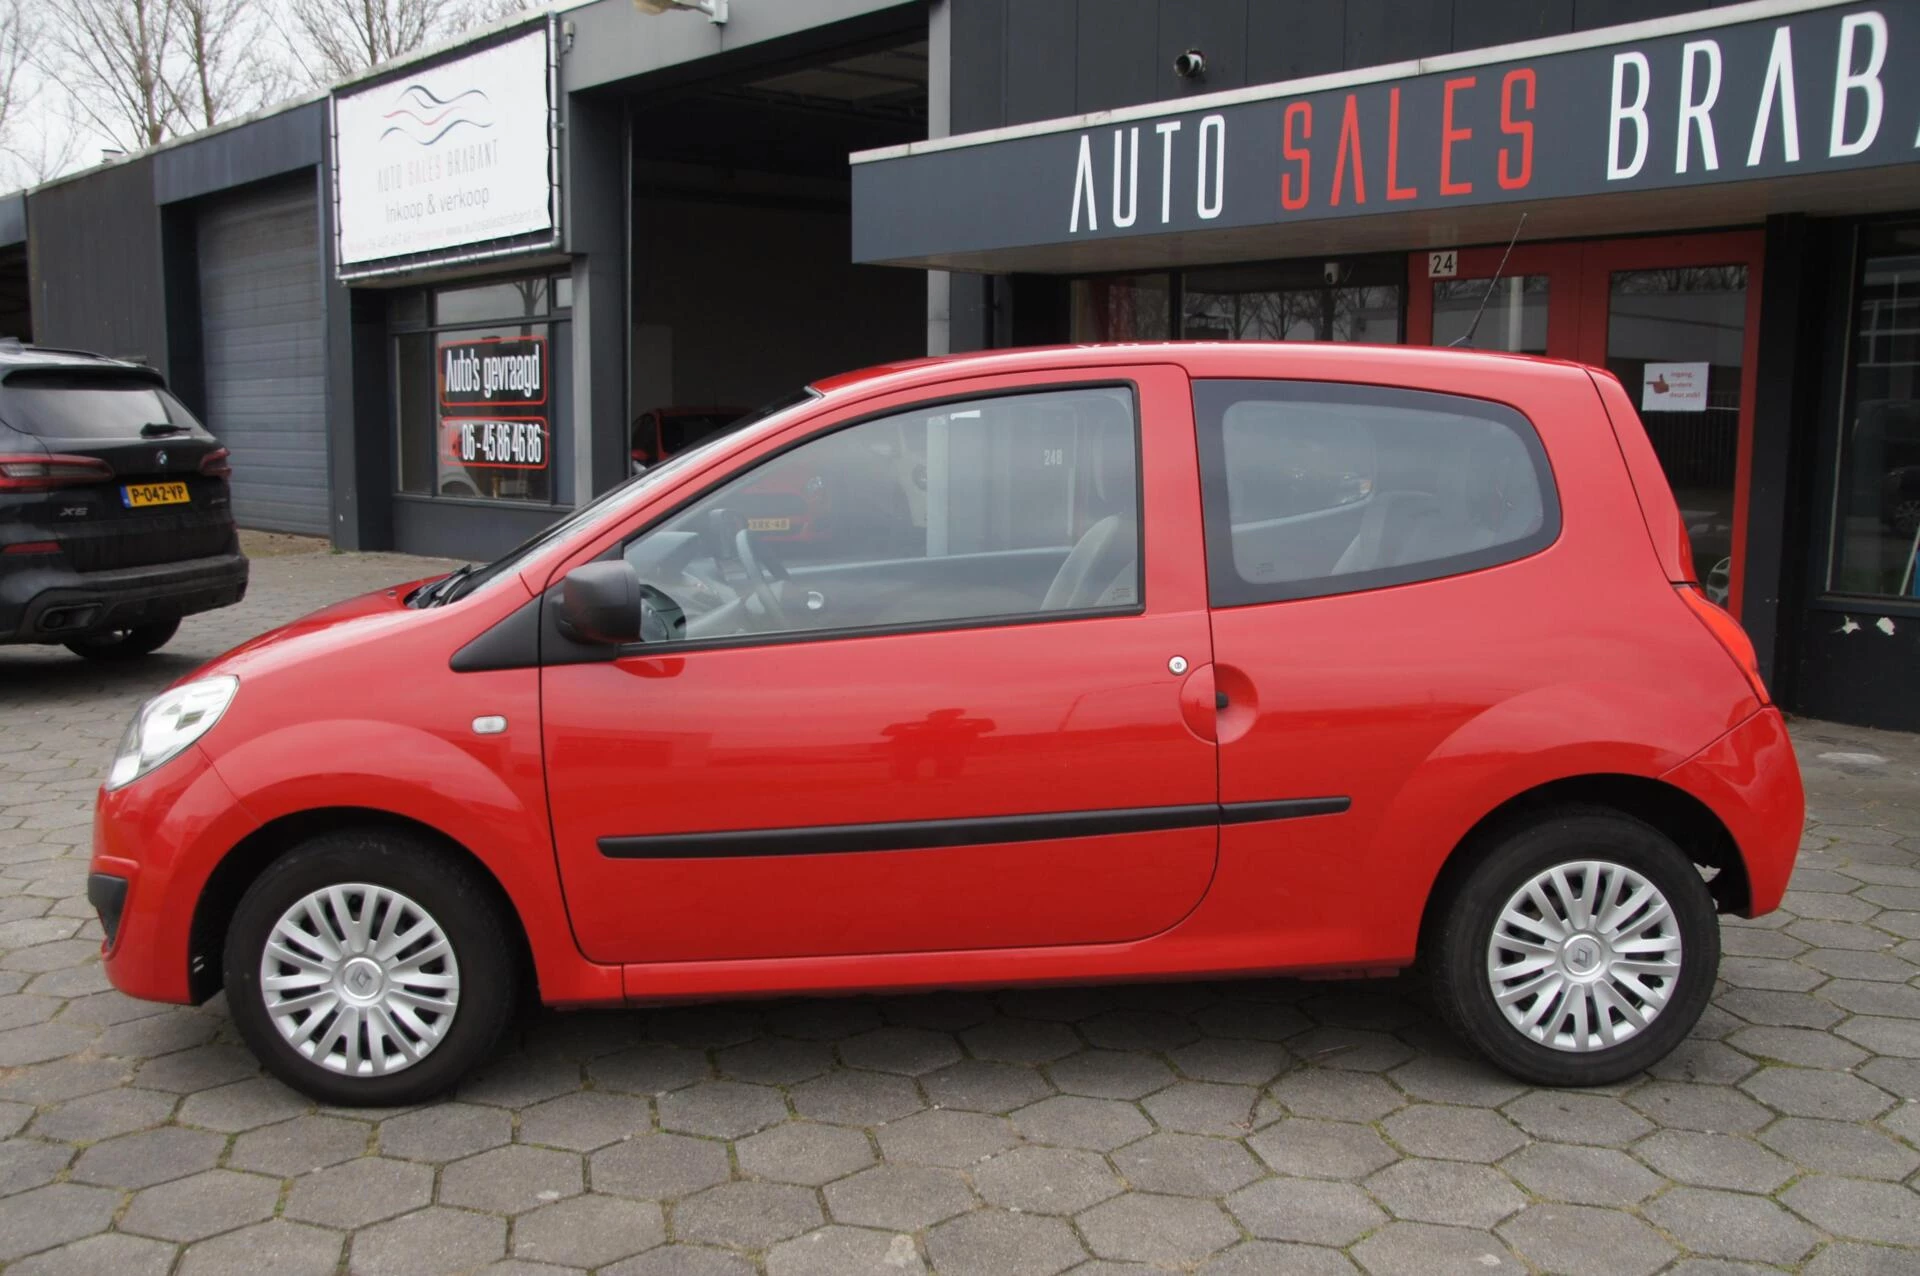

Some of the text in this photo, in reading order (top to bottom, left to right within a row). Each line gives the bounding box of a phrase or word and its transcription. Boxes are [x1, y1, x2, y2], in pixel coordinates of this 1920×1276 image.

[1069, 11, 1920, 233] AUTO SALES BRAB
[377, 138, 499, 193] AUTO SALES BRABANT
[385, 184, 490, 224] Inkoop & verkoop
[1432, 253, 1453, 273] 24
[446, 343, 540, 398] Auto's gevraagd
[462, 423, 475, 461] 06
[131, 484, 185, 504] P-042-VP
